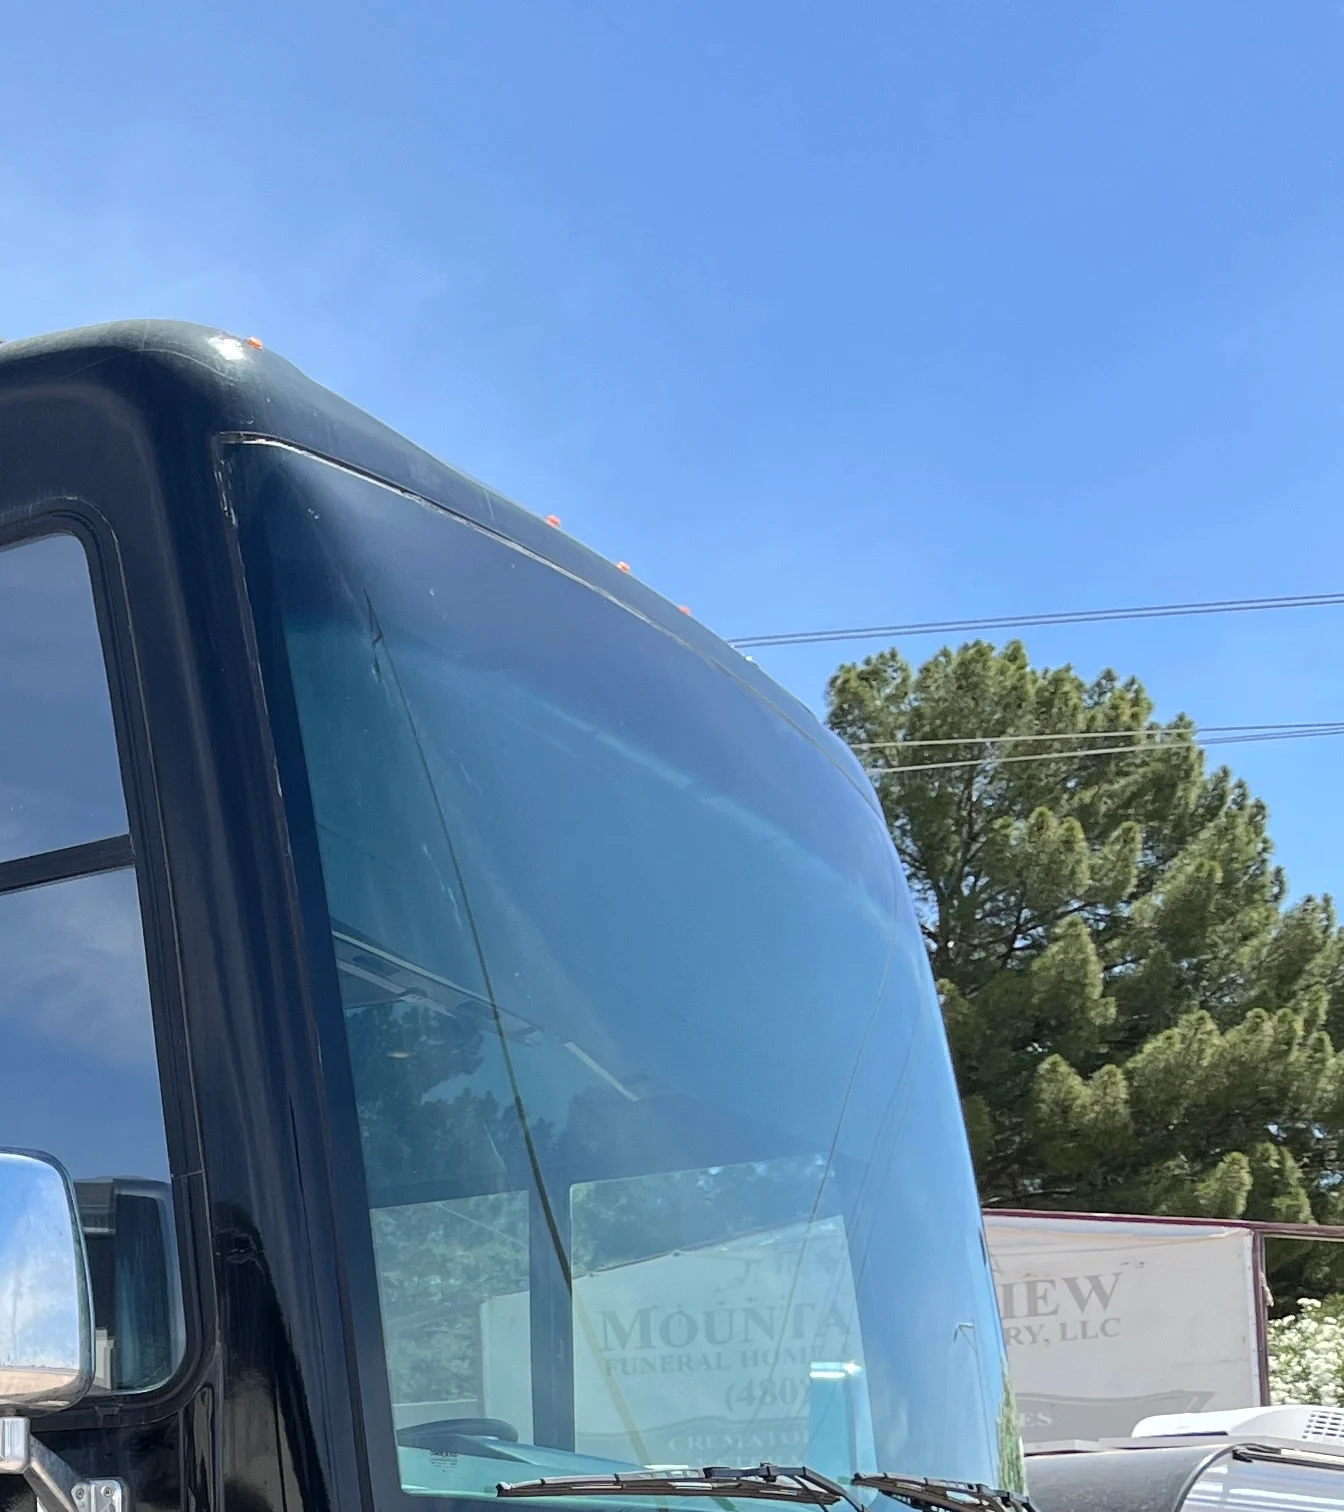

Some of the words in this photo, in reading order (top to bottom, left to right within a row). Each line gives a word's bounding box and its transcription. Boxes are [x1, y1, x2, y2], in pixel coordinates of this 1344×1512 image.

[596, 1302, 853, 1351] MOUNTA
[999, 1272, 1123, 1320] IEW
[606, 1351, 732, 1377] FUNERAL
[1004, 1324, 1051, 1347] RY,
[1060, 1318, 1121, 1342] LLC
